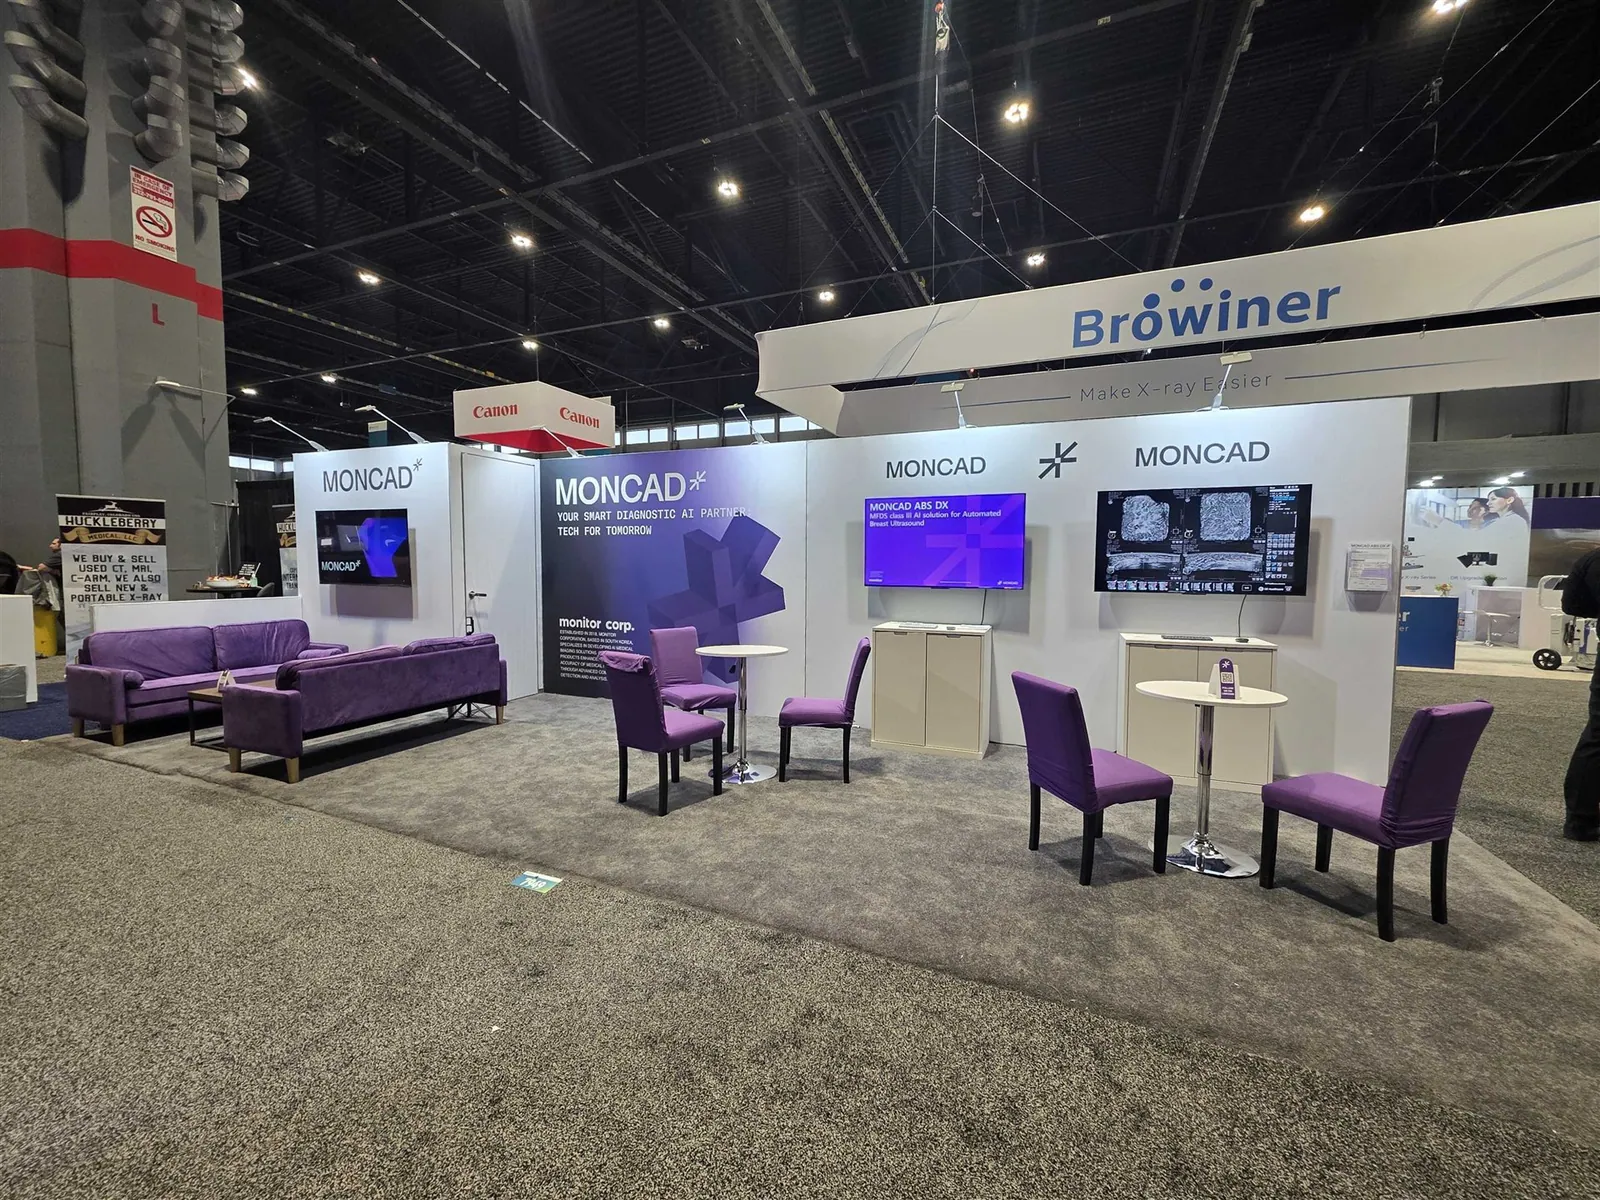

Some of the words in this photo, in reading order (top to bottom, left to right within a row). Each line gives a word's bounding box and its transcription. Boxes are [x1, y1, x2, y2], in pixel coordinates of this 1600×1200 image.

[132, 178, 172, 197] EMERGENCY
[144, 176, 160, 187] CASE
[146, 238, 175, 252] SMOKING
[152, 302, 165, 326] L
[1072, 284, 1341, 348] Browiner
[1080, 386, 1131, 402] Make
[1137, 380, 1196, 398] X-ray
[1203, 374, 1272, 393] Easier
[472, 404, 518, 419] Canon
[559, 406, 600, 429] Canon
[1135, 441, 1270, 468] MONCAD
[886, 456, 986, 478] MONCAD
[323, 466, 413, 492] MONCAD
[555, 472, 687, 506] MONCAD
[870, 502, 912, 511] MONCAD
[914, 502, 932, 510] ABS
[935, 501, 948, 510] DX
[66, 516, 157, 528] HUCKLEBERRY
[557, 512, 579, 522] YOUR
[584, 511, 612, 521] SMART
[616, 509, 676, 520] DIAGNOSTIC
[681, 509, 694, 518] AI
[558, 526, 579, 536] TECH
[584, 526, 601, 536] FOR
[606, 525, 652, 536] TOMORROW
[79, 565, 107, 573] USED
[322, 561, 356, 571] MONCAD
[71, 594, 125, 602] PORTABLE
[559, 616, 601, 629] monitor
[606, 620, 635, 633] corp.
